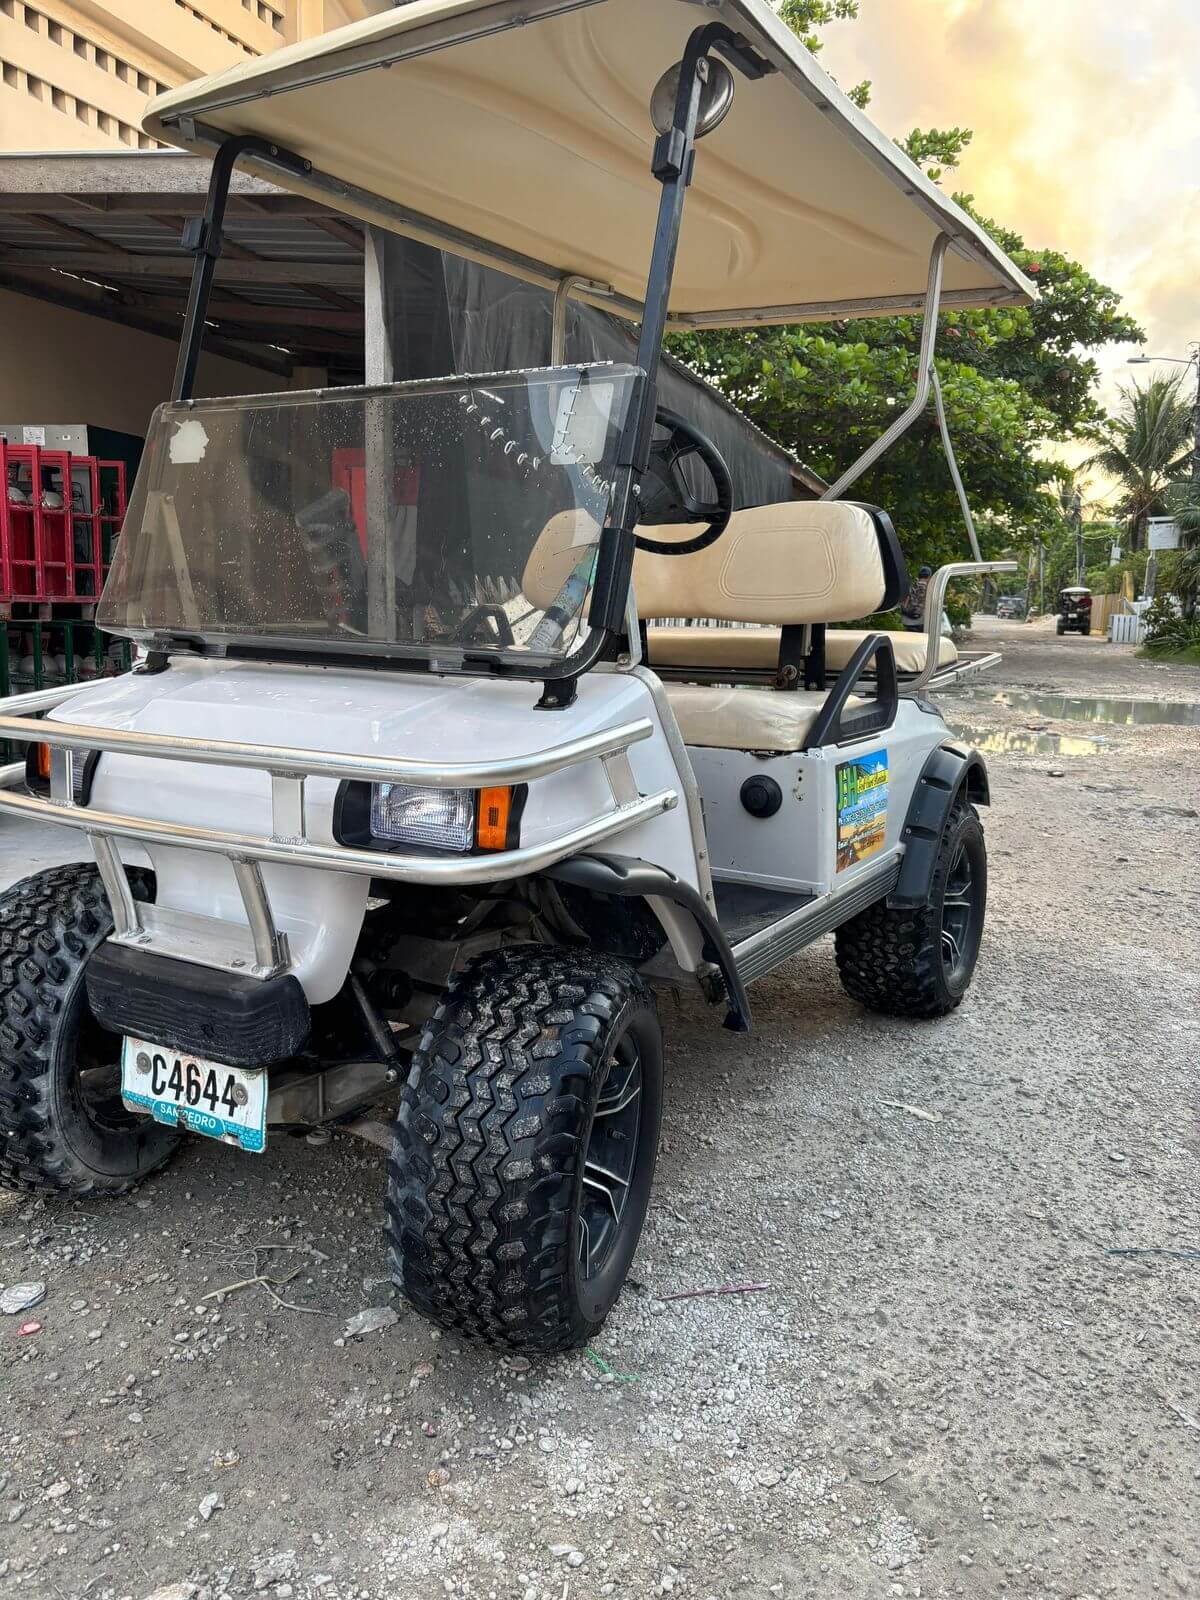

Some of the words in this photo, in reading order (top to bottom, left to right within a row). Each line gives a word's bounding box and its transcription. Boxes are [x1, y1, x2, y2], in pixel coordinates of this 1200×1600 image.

[151, 1054, 239, 1118] C4644
[160, 1103, 180, 1118] SAN
[181, 1110, 217, 1129] PEDRO
